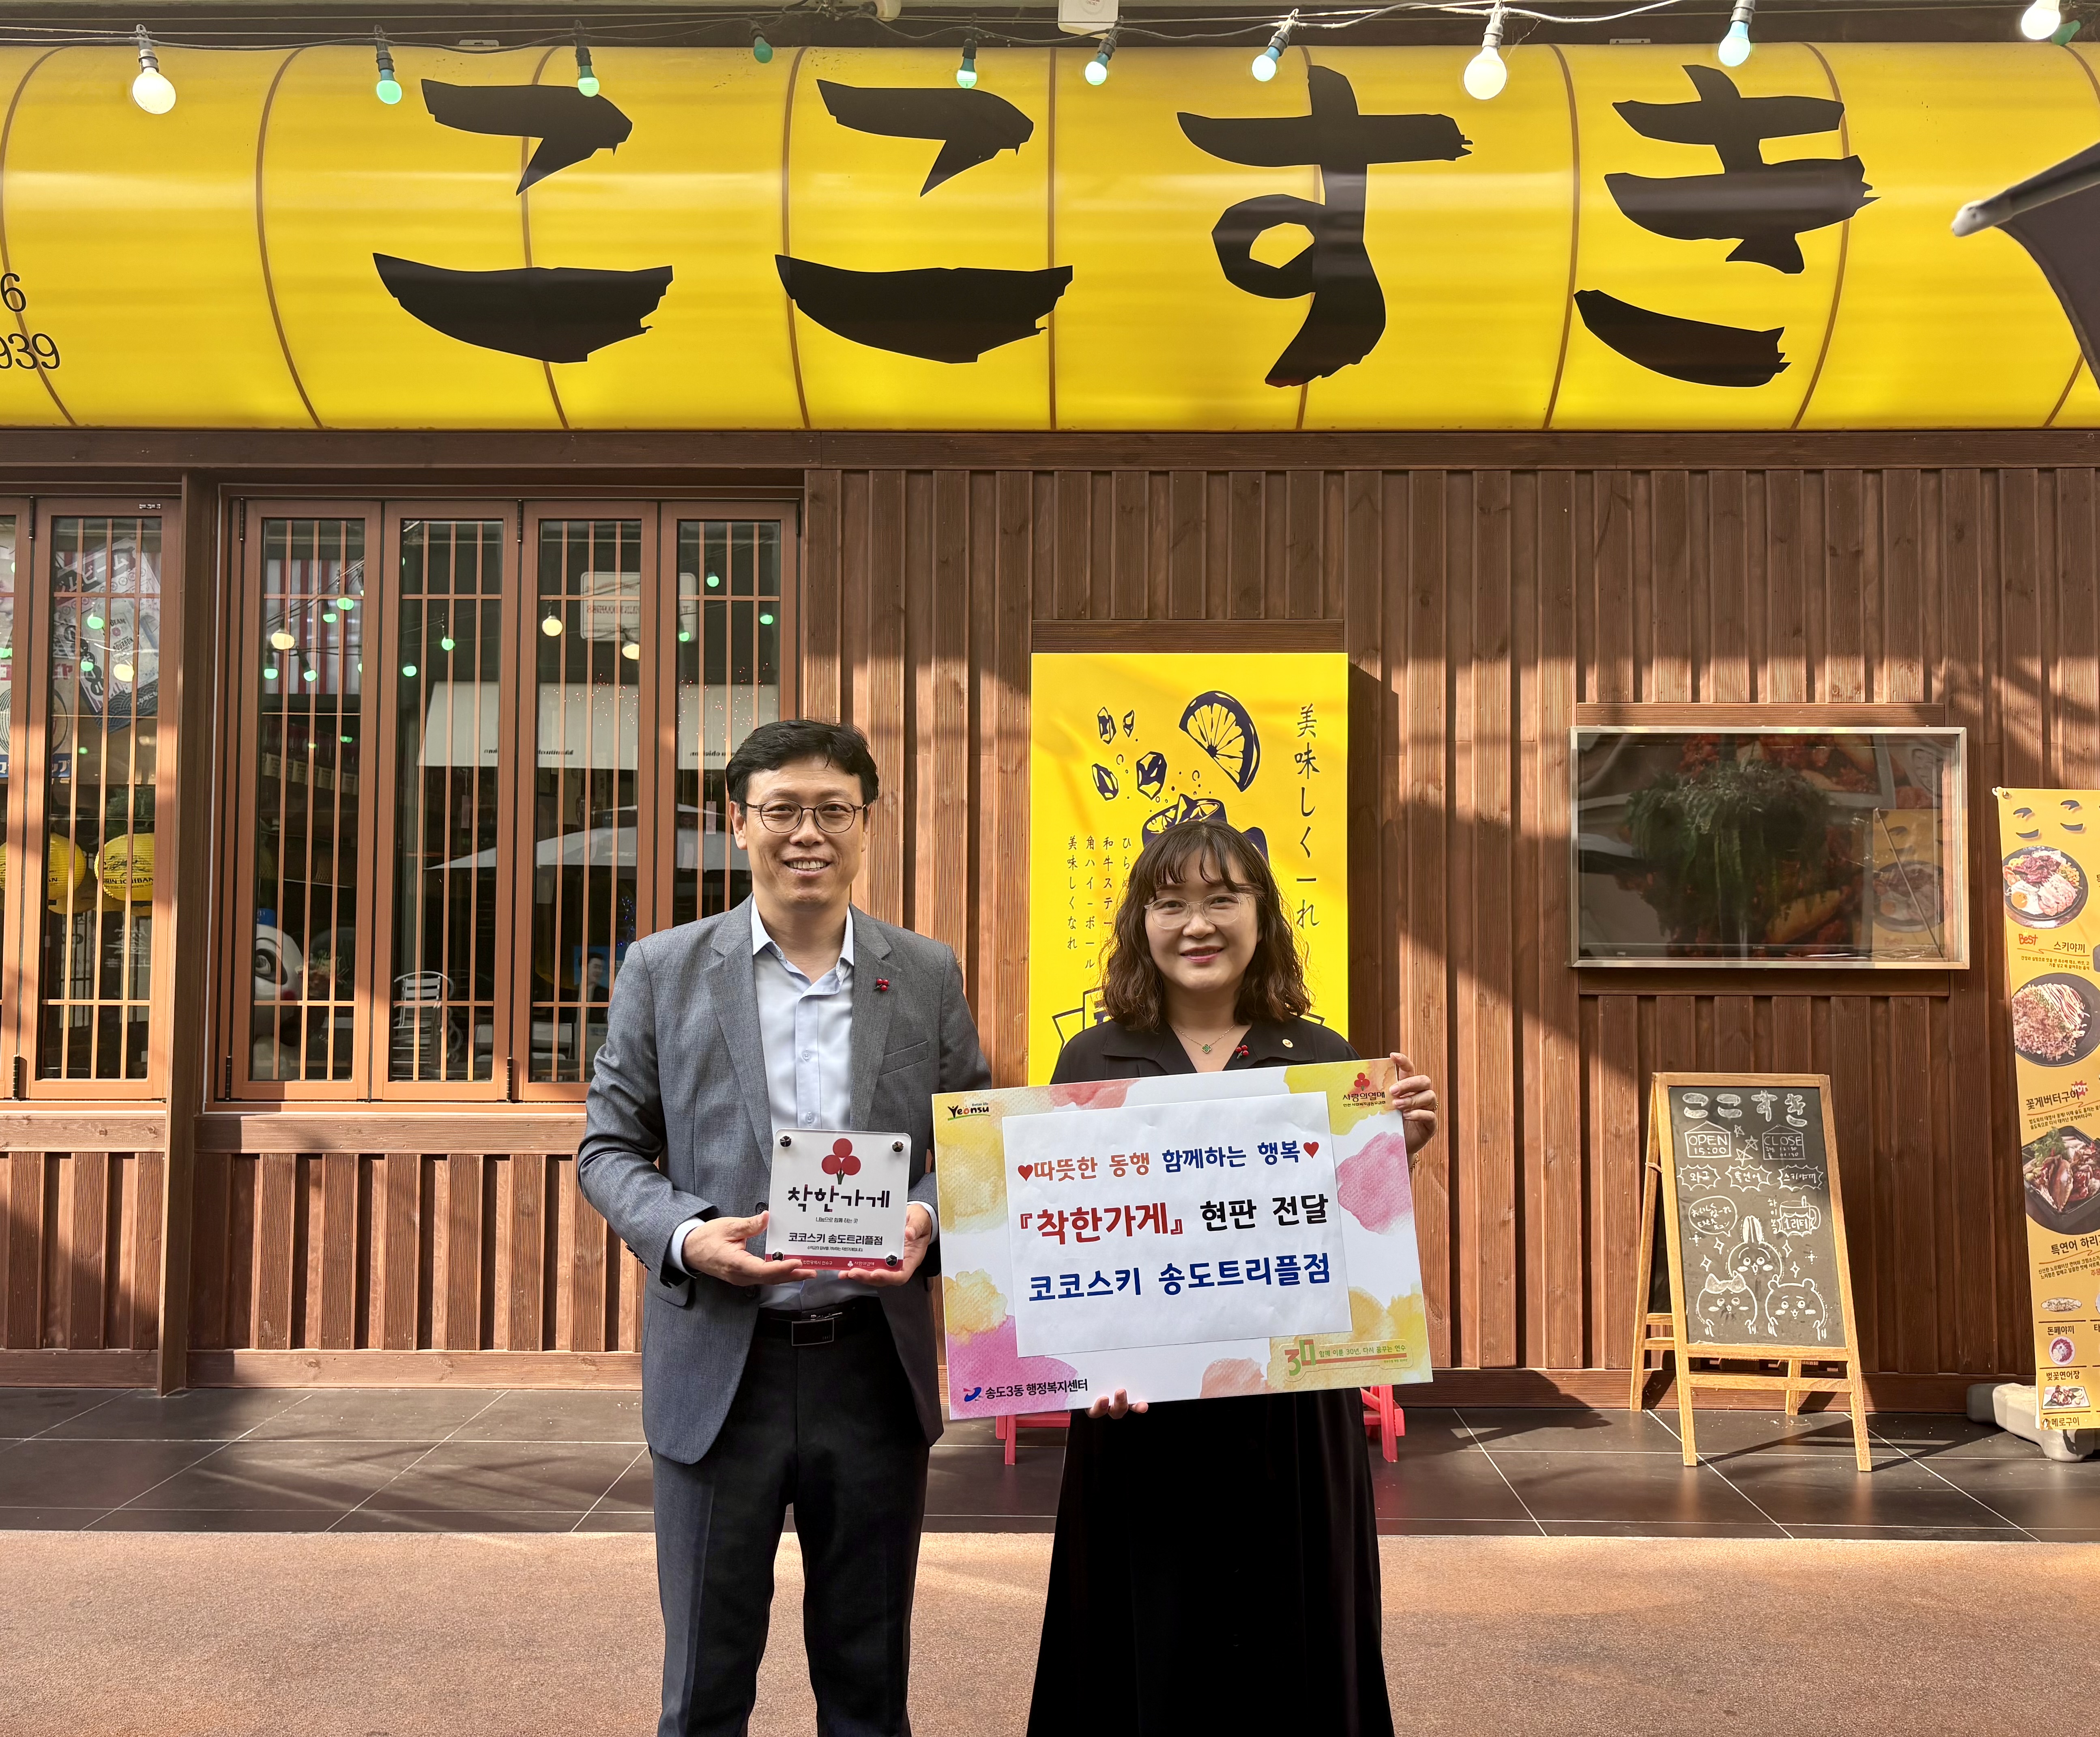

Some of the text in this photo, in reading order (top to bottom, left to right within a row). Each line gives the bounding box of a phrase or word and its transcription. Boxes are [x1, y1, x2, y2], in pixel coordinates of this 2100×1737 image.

[373, 65, 1875, 388] ここすき
[1067, 835, 1078, 950] 美味しくなれ
[2018, 934, 2038, 946] Best
[2053, 942, 2085, 953] 스키야끼
[1342, 1092, 1385, 1102] 사랑의열매
[2026, 1090, 2079, 1110] 꽃게버터구이
[947, 1105, 989, 1118] Yeonsu
[1682, 1090, 1807, 1127] ここすき
[1688, 1135, 1728, 1146] OPEN
[1764, 1135, 1802, 1146] CLOSE
[1034, 1140, 1300, 1182] 따뜻한 동행 함께하는 행복
[788, 1185, 890, 1212] 착한가게
[1020, 1194, 1328, 1245] 『착한가게』 현판 전달
[789, 1232, 883, 1245] 코코스키 송도트리플점
[2051, 1235, 2100, 1255] 특연어 하리
[1029, 1253, 1330, 1301] 코코스키 송도트리플점
[2047, 1325, 2074, 1335] 돈페야끼
[2046, 1370, 2080, 1381] 벚꽃연어장
[985, 1378, 1088, 1399] 송도3동 행정복지센터
[2052, 1417, 2080, 1427] 메로구이
